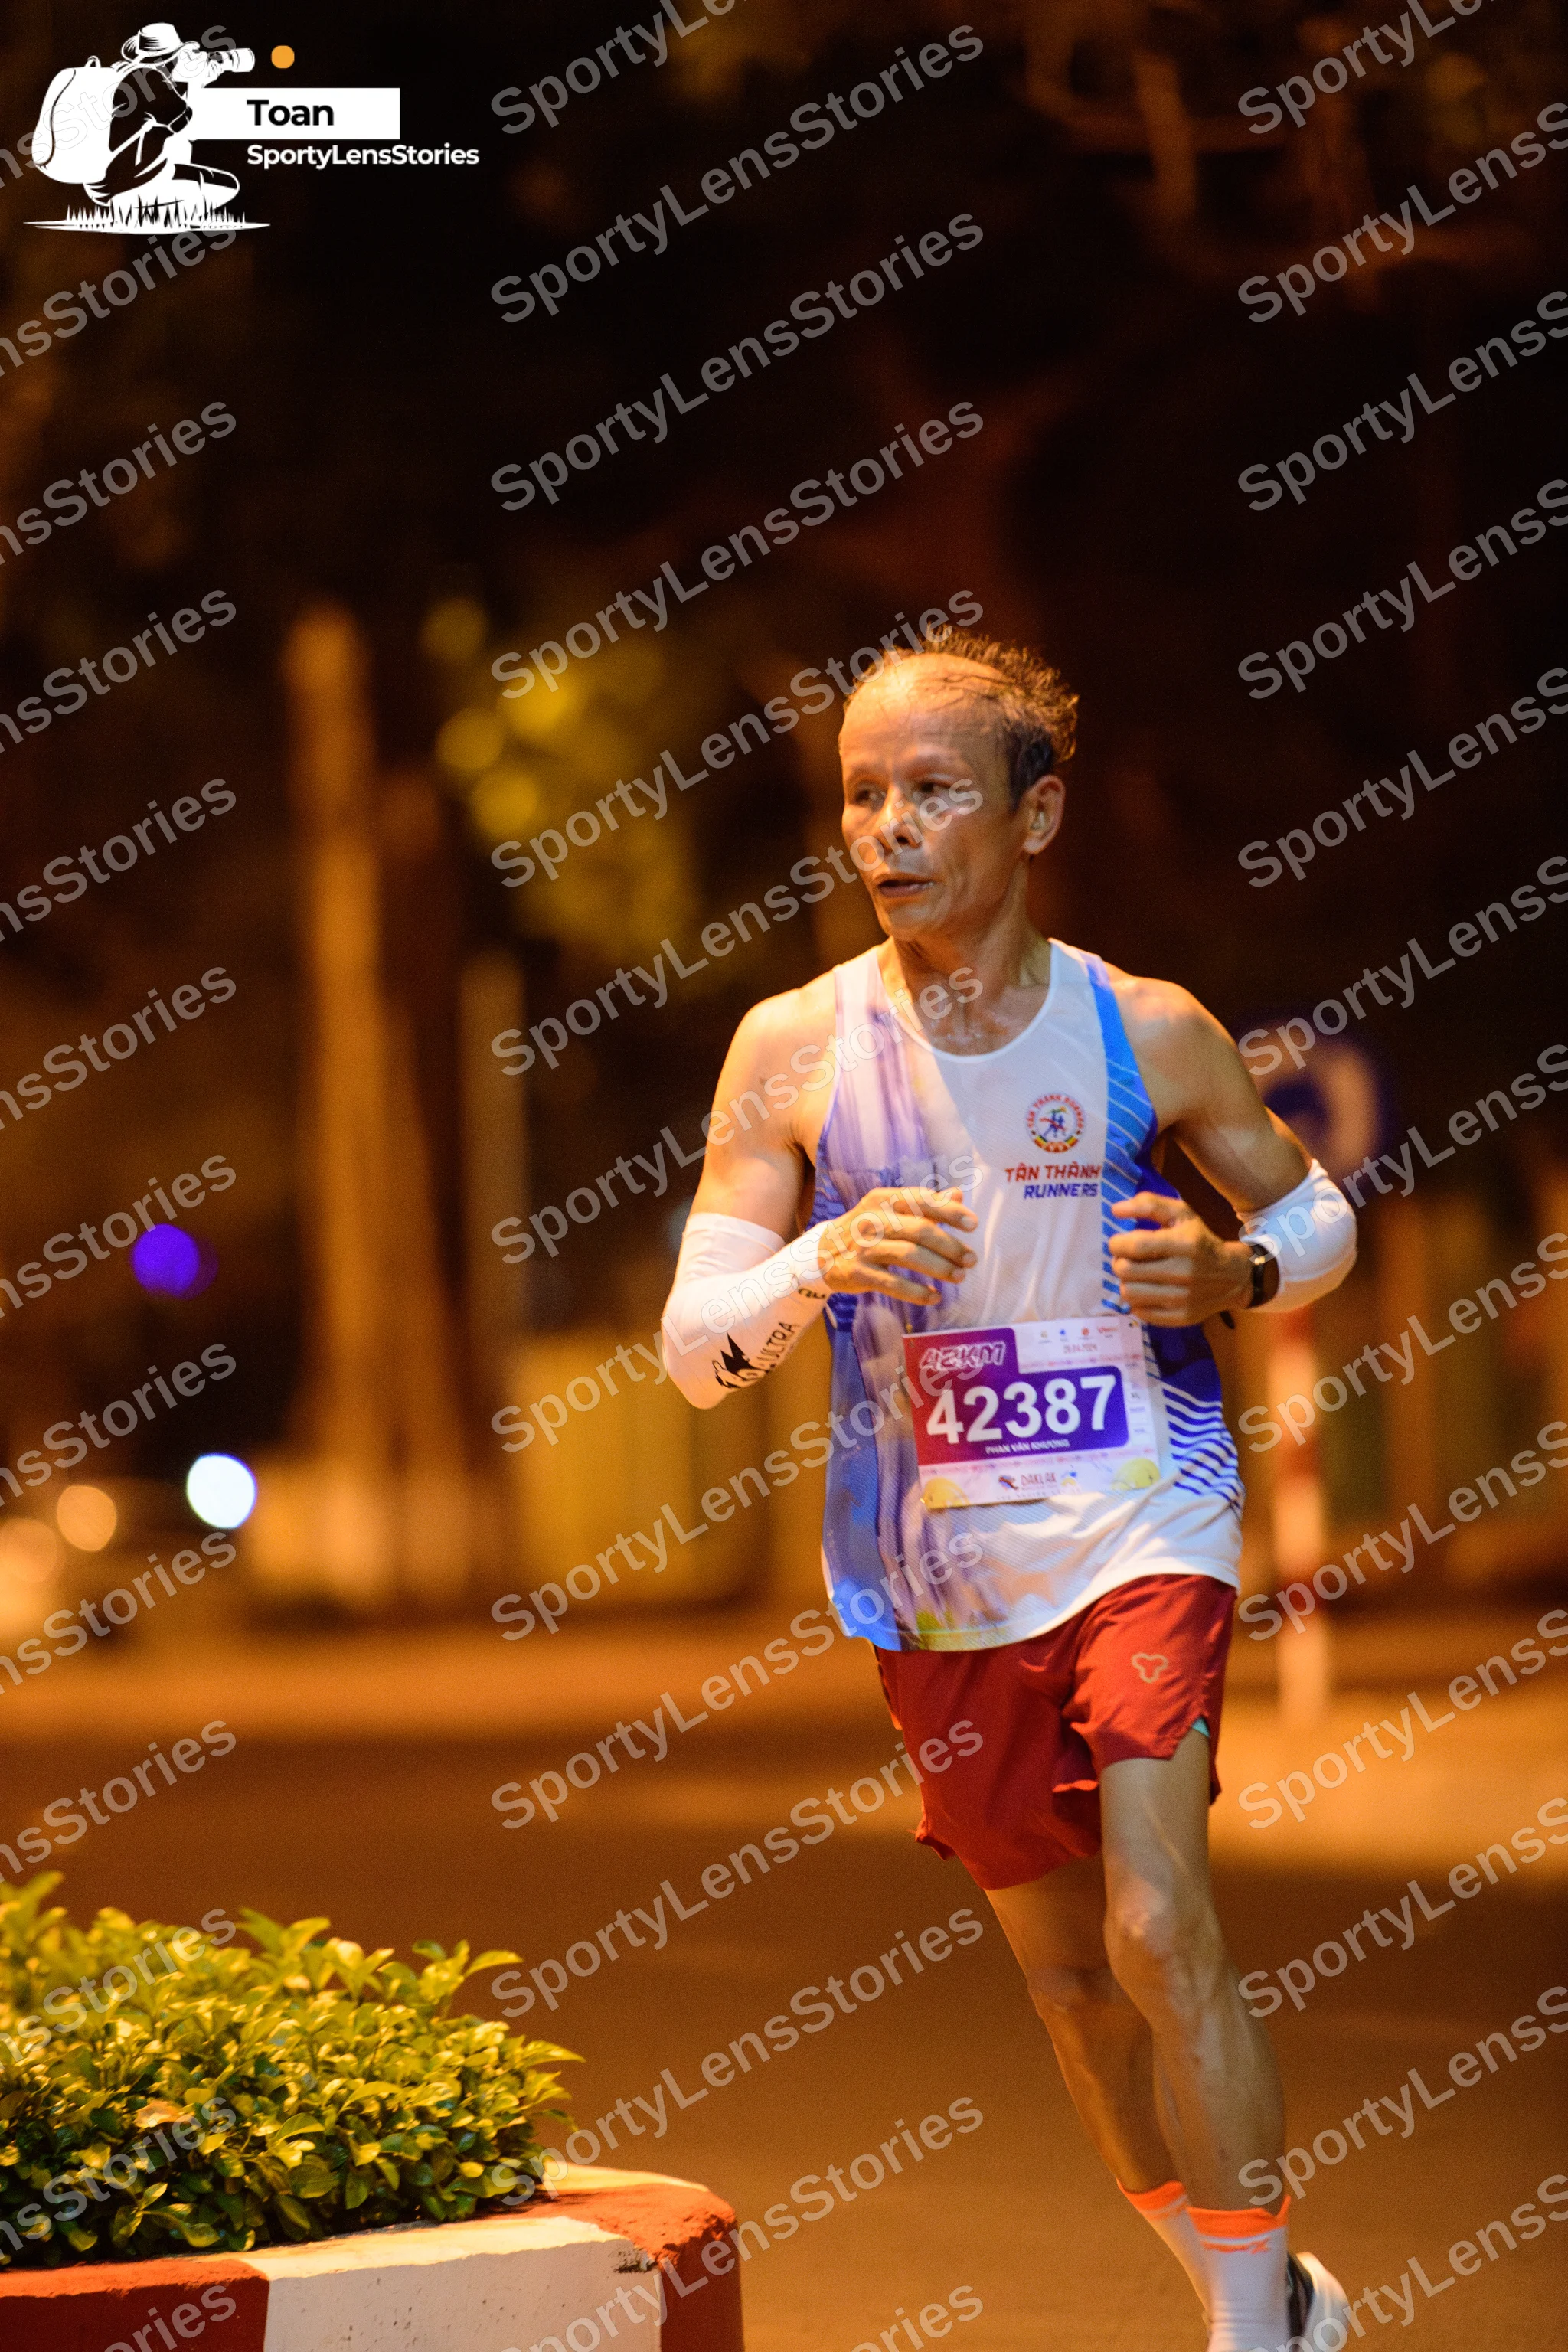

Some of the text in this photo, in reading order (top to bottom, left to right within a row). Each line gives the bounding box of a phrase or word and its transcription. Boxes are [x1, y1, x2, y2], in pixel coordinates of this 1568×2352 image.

[1004, 1160, 1102, 1183] TÂN THÀNH
[1023, 1183, 1099, 1200] RUNNERS
[926, 1375, 1116, 1444] 42387
